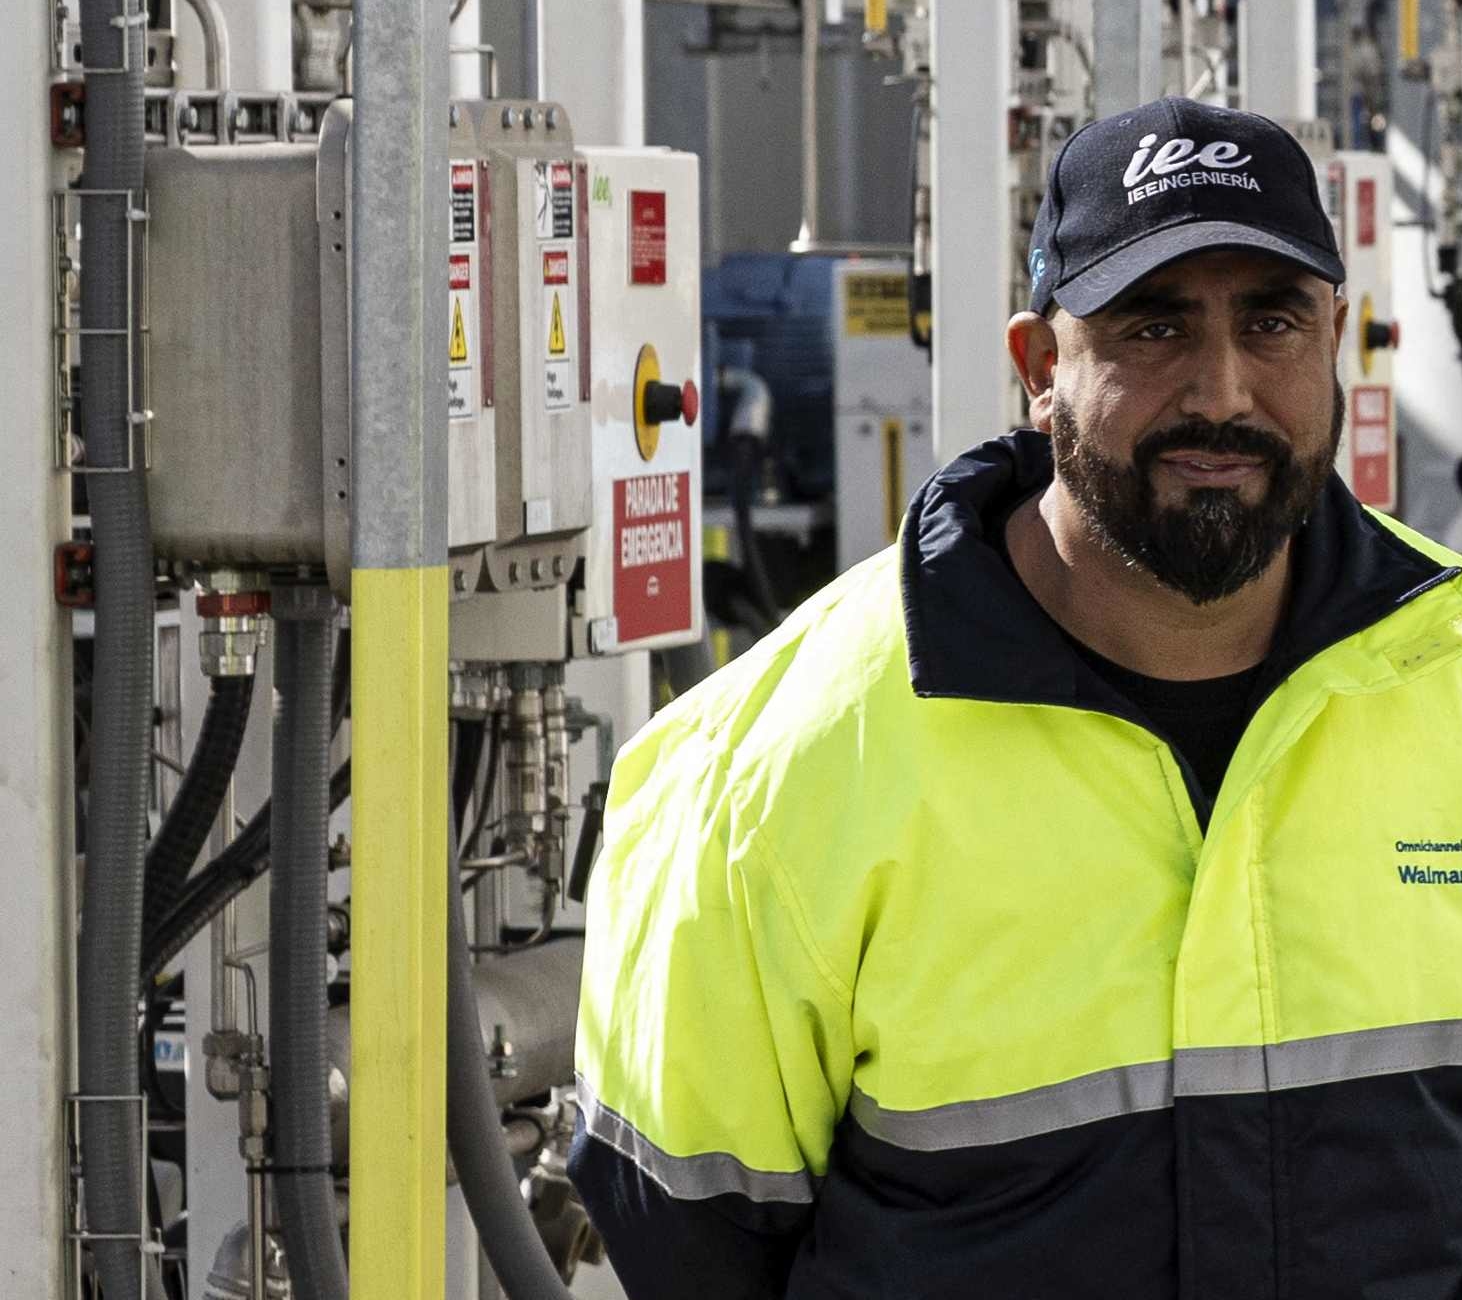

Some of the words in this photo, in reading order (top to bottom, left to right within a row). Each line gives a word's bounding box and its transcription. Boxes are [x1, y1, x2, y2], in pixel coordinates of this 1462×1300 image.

[1122, 133, 1252, 188] iee
[625, 476, 664, 519] PARADA
[664, 473, 680, 512] DE
[621, 519, 684, 569] EMERGENCIA
